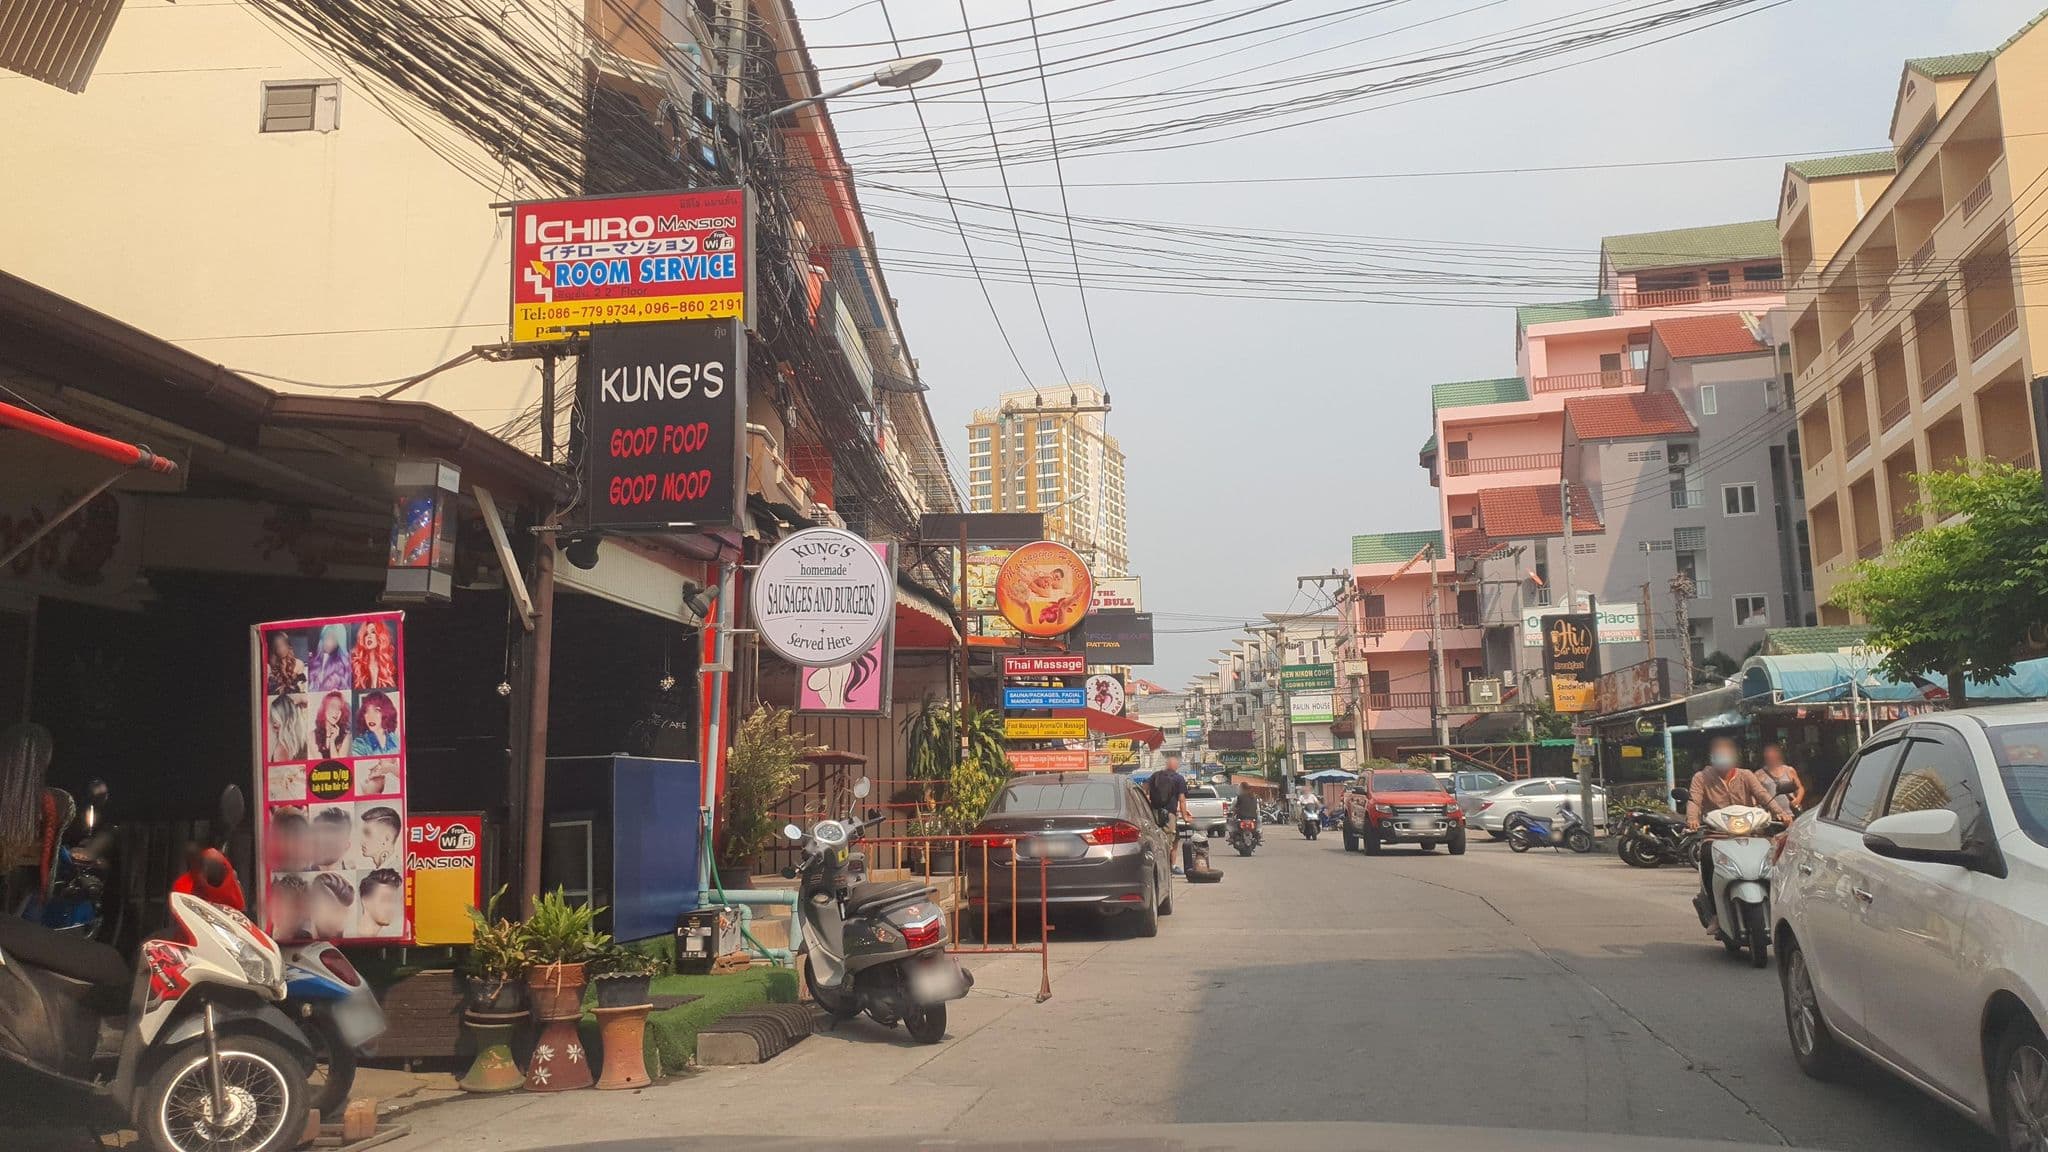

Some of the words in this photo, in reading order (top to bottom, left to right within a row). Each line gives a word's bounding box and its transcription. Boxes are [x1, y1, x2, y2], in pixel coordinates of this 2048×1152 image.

[525, 214, 655, 245] ICHIRO
[658, 215, 737, 233] MANSION
[543, 239, 696, 261] イチローマンション
[555, 260, 631, 288] ROOM
[640, 253, 736, 284] SERVICE
[710, 298, 741, 312] 2191
[601, 361, 725, 403] KUNG'S
[610, 426, 659, 458] GOOD
[663, 422, 710, 454] FOOD
[609, 473, 658, 506] GOOD
[662, 469, 712, 502] MOOD
[790, 542, 856, 559] KUNG'S
[800, 564, 848, 576] homemade
[767, 583, 813, 616] SAUSAGES
[814, 587, 833, 613] AND
[834, 584, 876, 617] BURGERS
[1103, 598, 1135, 607] BULL
[1596, 611, 1635, 624] Place
[787, 632, 824, 651] Served
[827, 635, 854, 650] Here
[1007, 660, 1031, 671] Thai
[1034, 659, 1082, 671] Massage
[1557, 683, 1585, 691] Sandwich
[1312, 702, 1330, 710] HOUSE
[407, 852, 476, 870] MANSION
